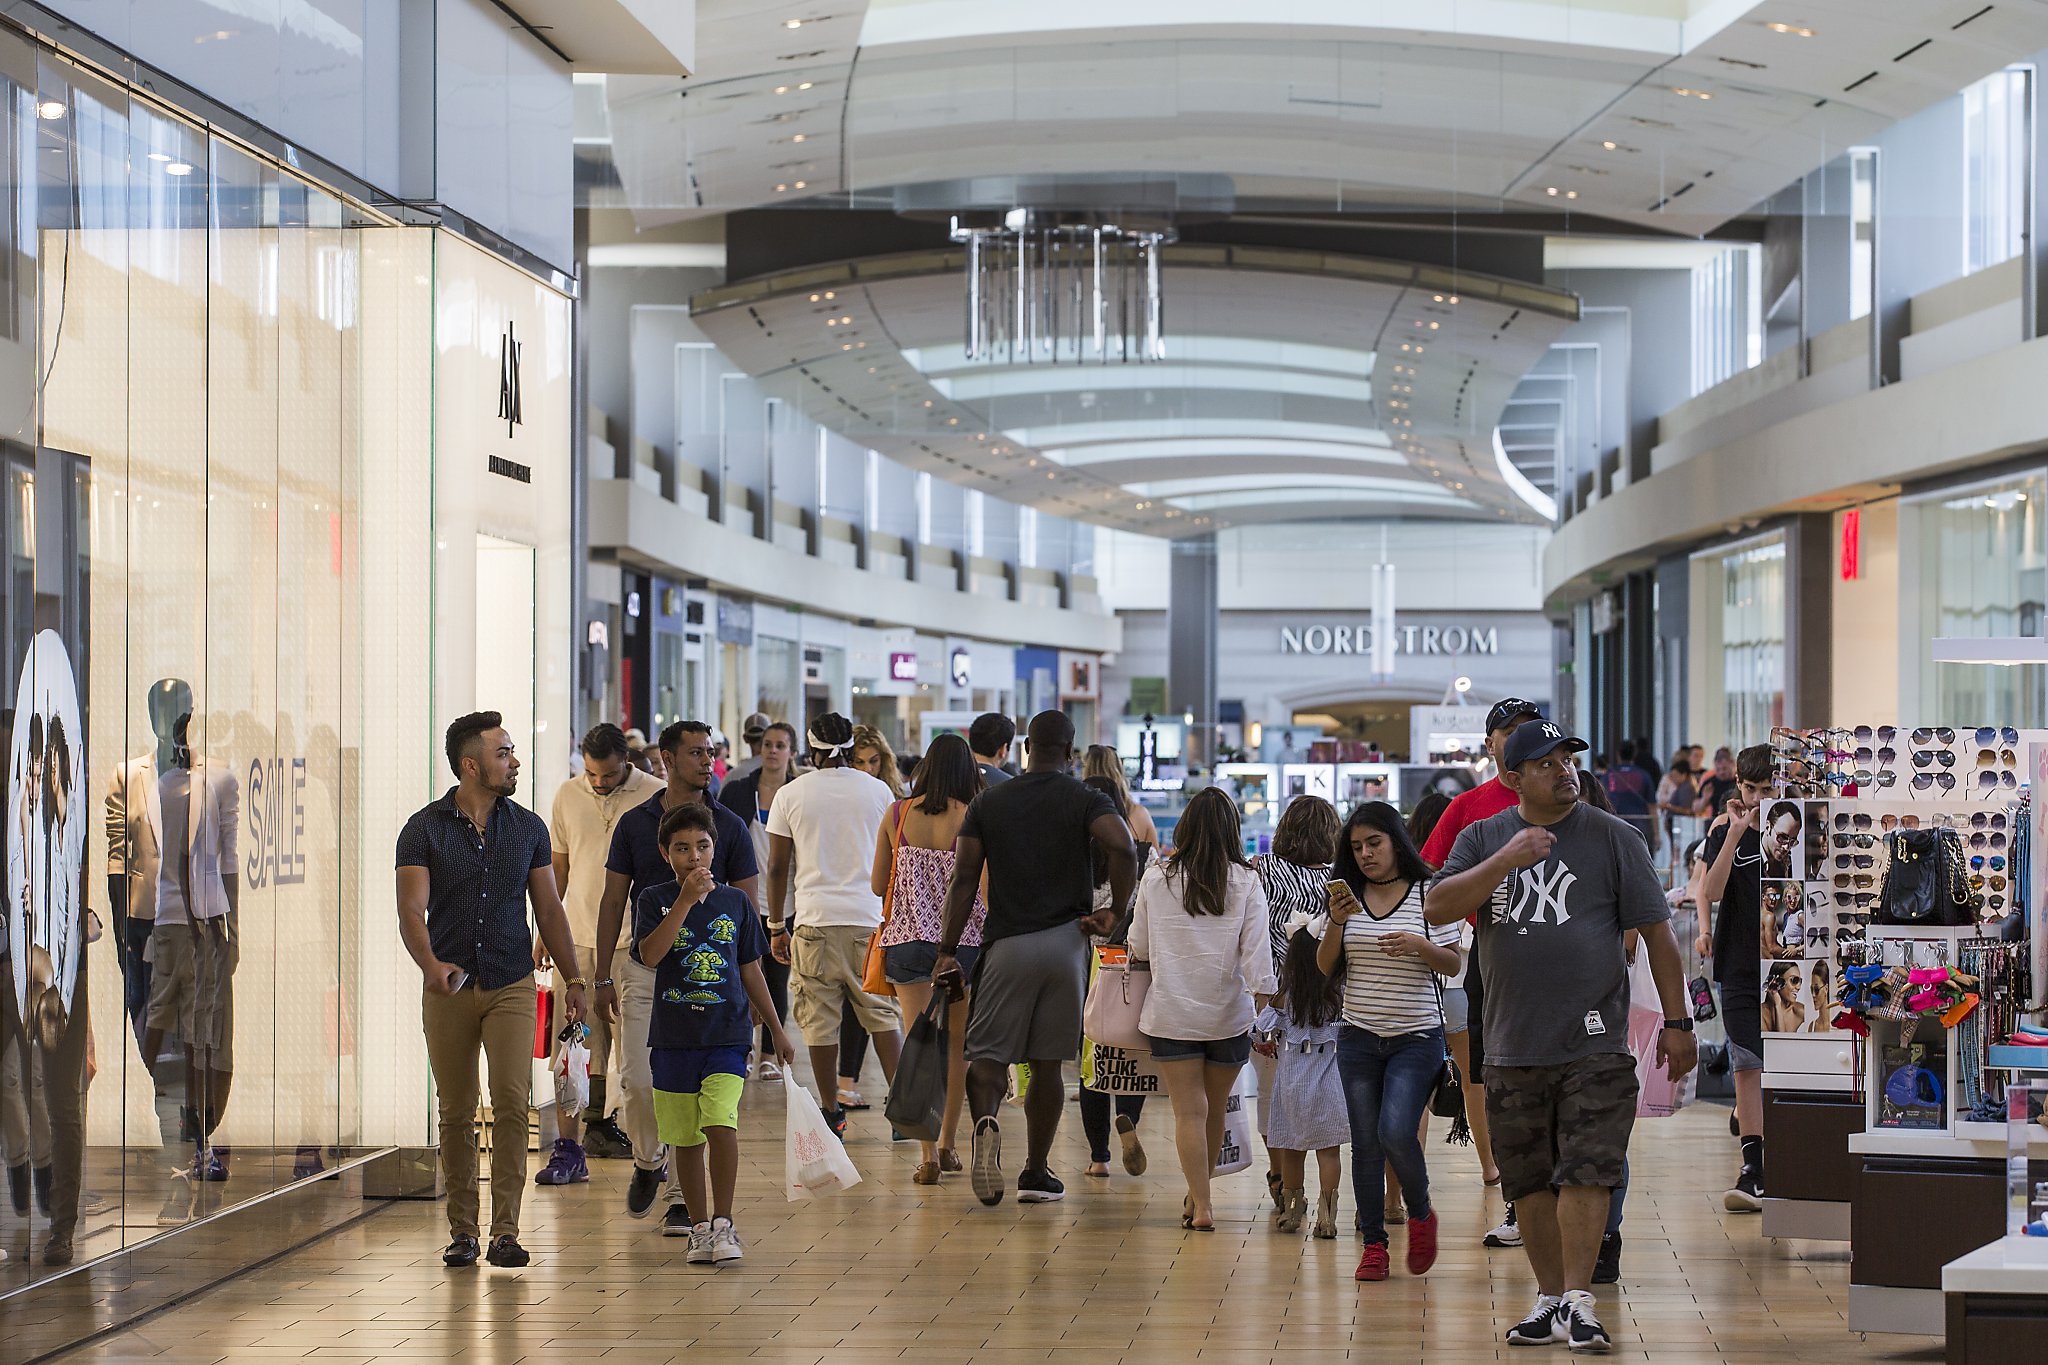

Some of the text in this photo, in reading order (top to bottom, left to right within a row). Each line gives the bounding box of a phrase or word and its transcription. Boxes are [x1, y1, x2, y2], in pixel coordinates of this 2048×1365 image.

[1281, 624, 1499, 656] NORDTROM
[247, 757, 306, 890] SALE
[1492, 873, 1509, 925] YANK
[1094, 1044, 1126, 1060] SALE
[1095, 1059, 1138, 1076] IS LIKE
[1112, 1074, 1158, 1091] OTHER
